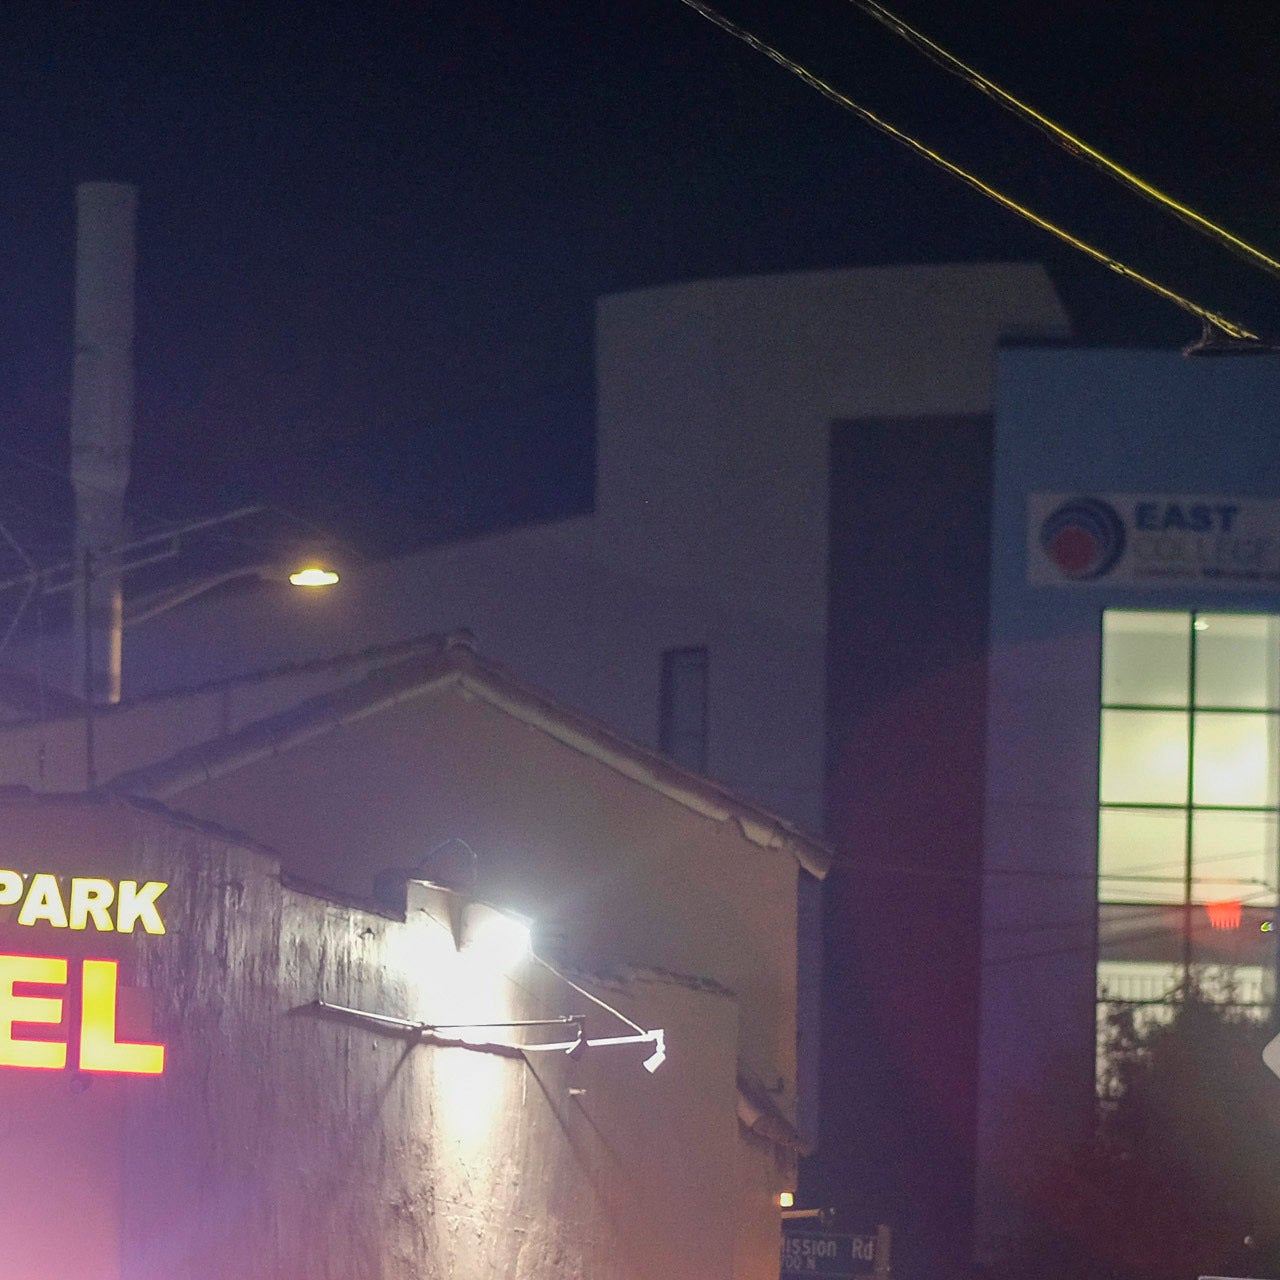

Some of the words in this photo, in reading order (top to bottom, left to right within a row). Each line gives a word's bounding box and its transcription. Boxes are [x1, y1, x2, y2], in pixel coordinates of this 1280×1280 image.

[1134, 502, 1238, 532] EAST
[781, 1238, 838, 1258] ission
[851, 1237, 874, 1261] Rd
